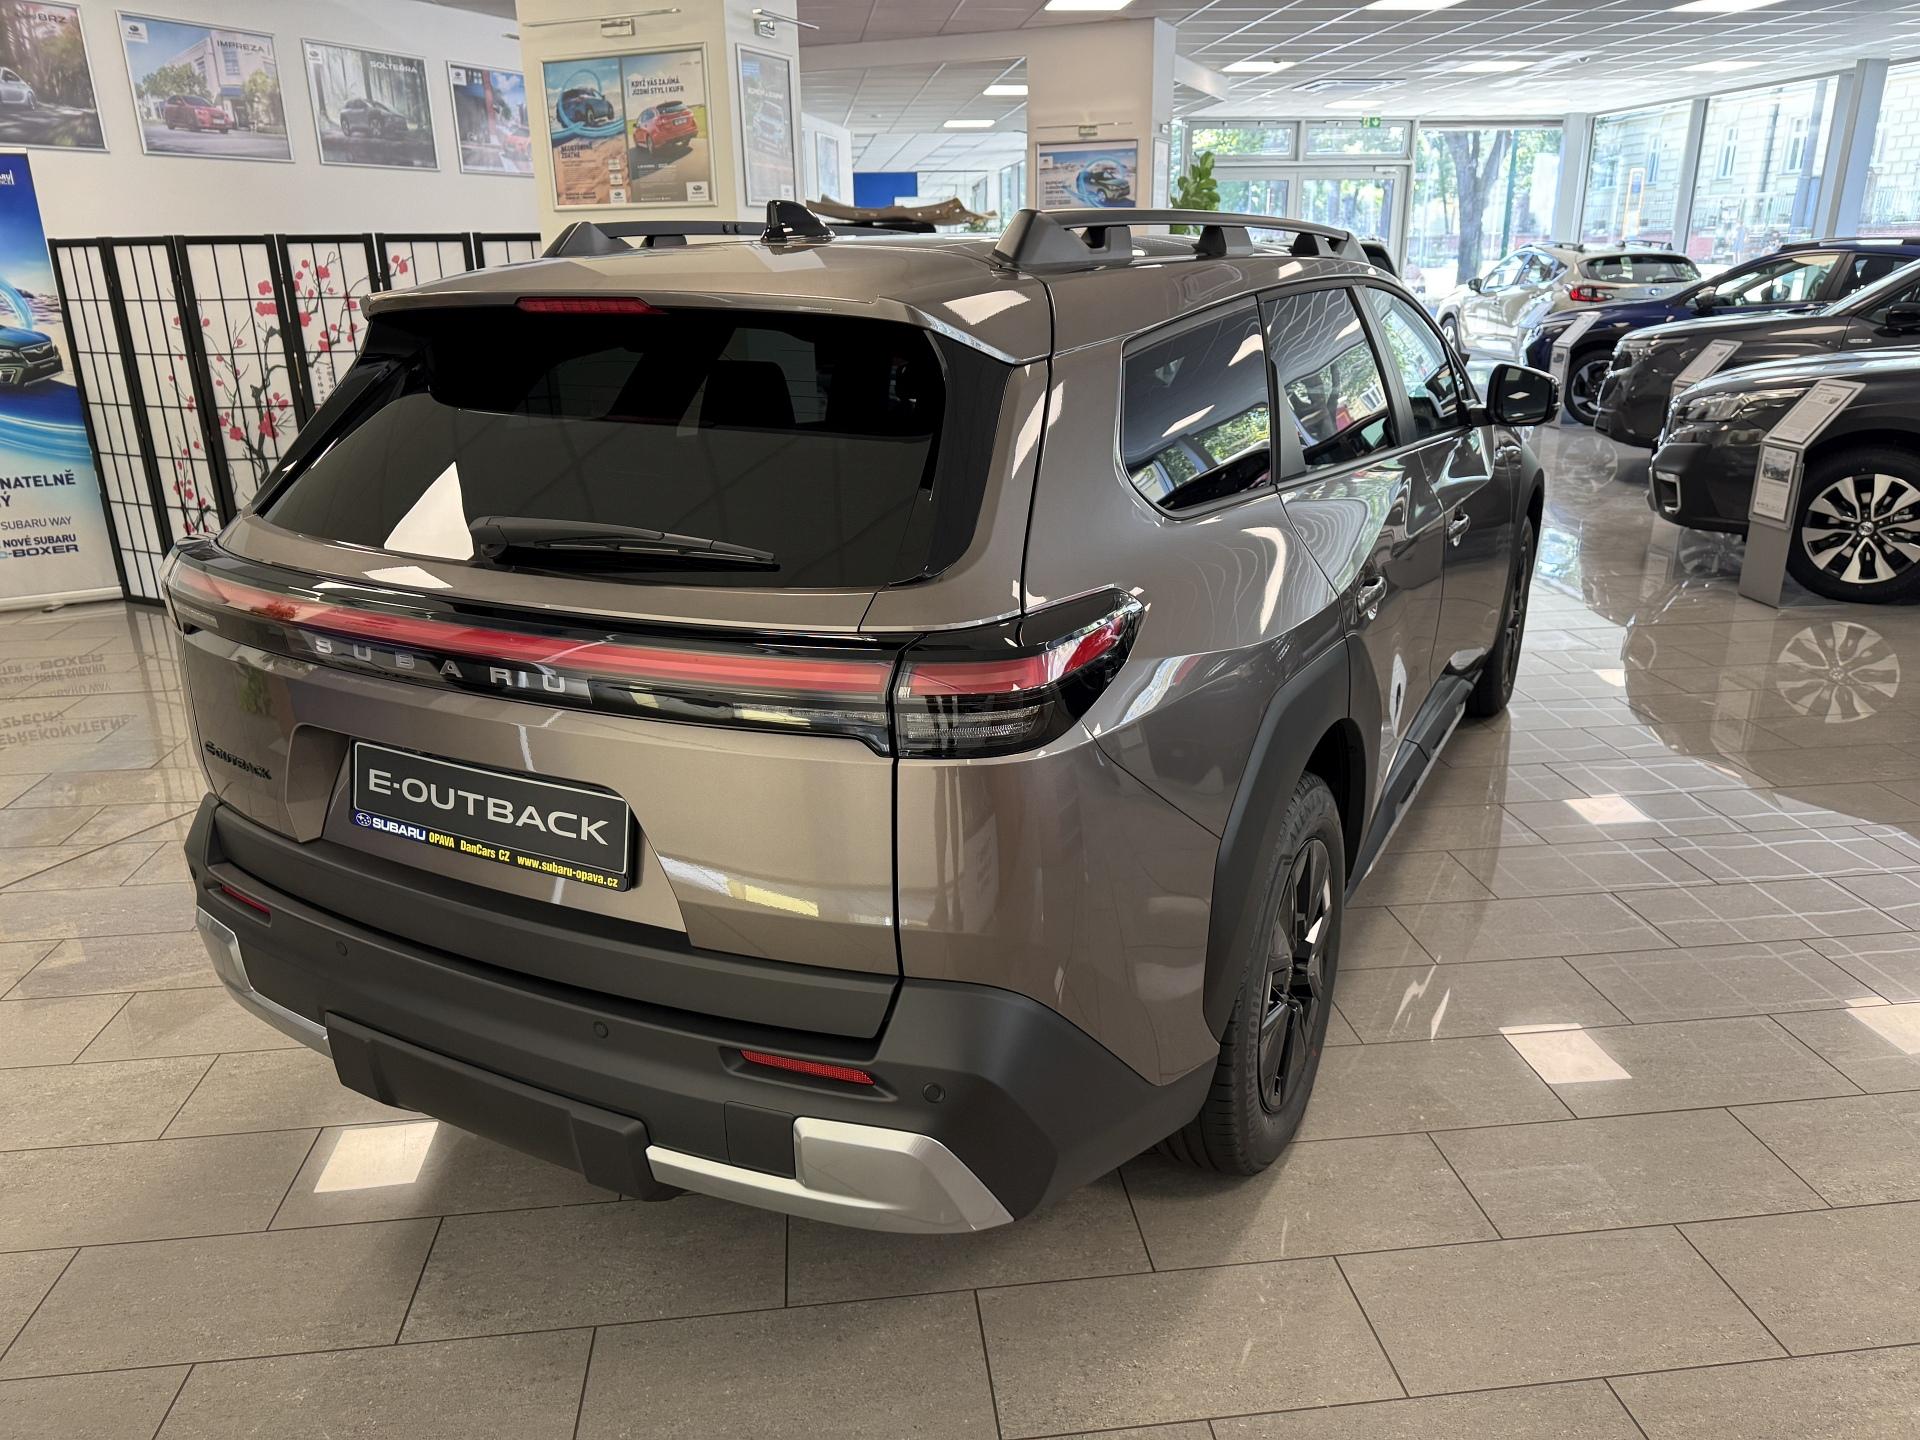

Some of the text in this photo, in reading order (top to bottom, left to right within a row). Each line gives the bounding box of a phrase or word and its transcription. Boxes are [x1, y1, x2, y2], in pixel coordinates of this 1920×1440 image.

[37, 12, 66, 24] BRZ
[217, 39, 265, 53] IMPREZA
[369, 60, 418, 74] SOLTERRA
[0, 469, 76, 490] NATELNĚ
[0, 491, 11, 508] Ý
[1, 516, 72, 531] SUBARU WAY
[3, 533, 77, 548] NOVÉ SUBARU
[315, 638, 566, 693] SUBARU
[368, 768, 609, 846] E-OUTBACK
[372, 816, 619, 888] SUBARU OPAVA DanCars CZ www.subaru-opava.cz
